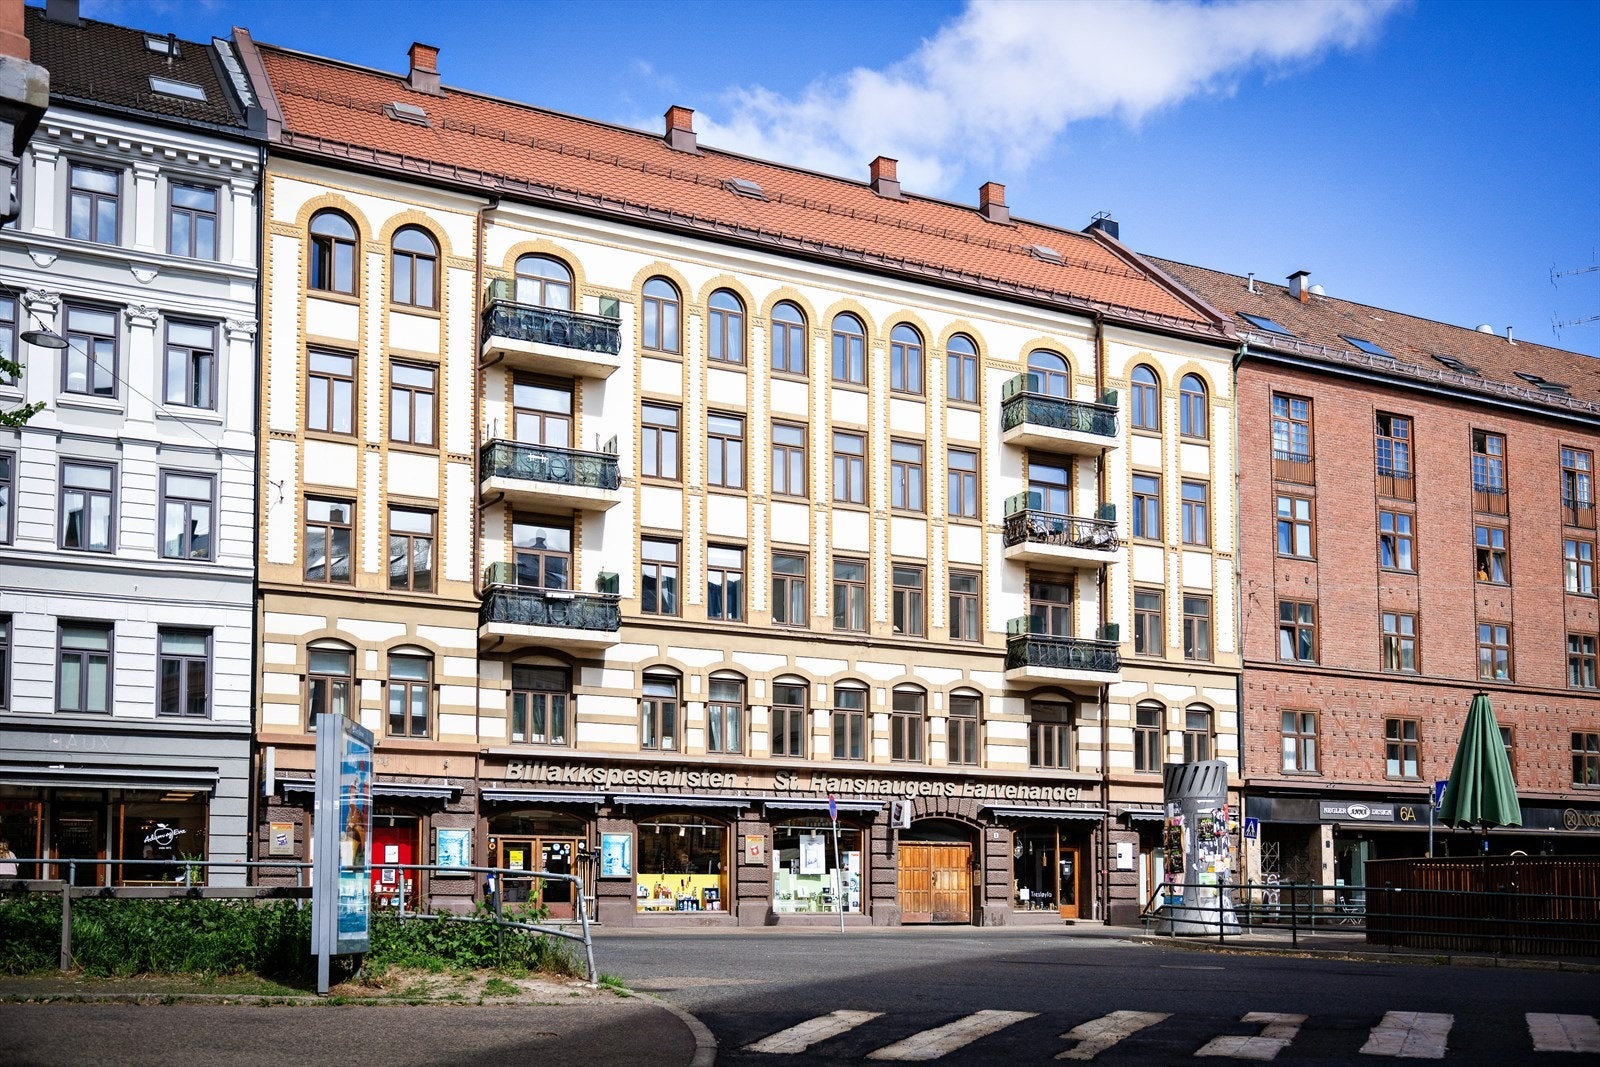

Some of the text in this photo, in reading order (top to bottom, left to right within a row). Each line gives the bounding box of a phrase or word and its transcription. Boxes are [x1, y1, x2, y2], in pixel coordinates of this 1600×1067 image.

[505, 759, 738, 789] Billakkspesialisten
[810, 772, 956, 799] Hanshaugens
[962, 780, 1082, 801] Farvehandel
[1371, 808, 1392, 816] DESIGN
[1399, 806, 1417, 822] 6A
